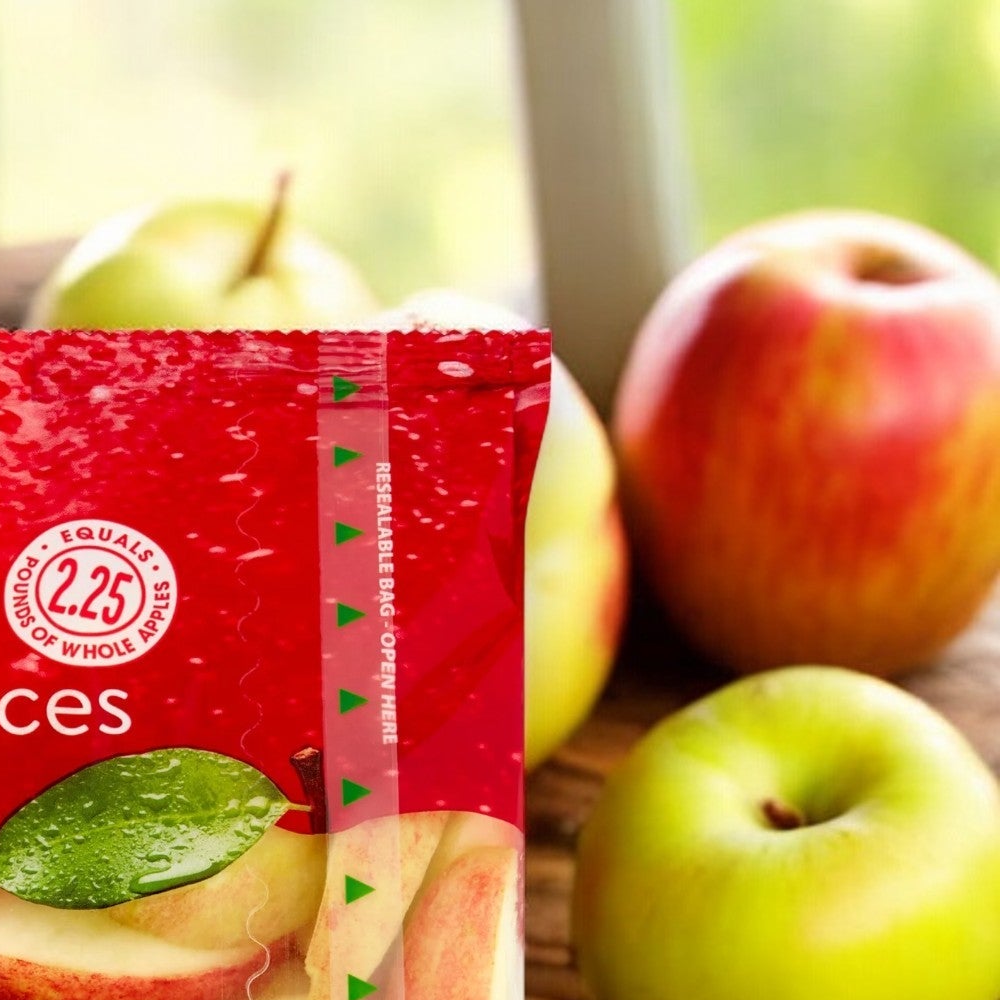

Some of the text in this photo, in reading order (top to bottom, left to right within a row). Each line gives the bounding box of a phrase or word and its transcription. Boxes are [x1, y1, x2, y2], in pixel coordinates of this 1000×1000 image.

[60, 526, 153, 563] EQUALS
[375, 462, 394, 574] RESEALABLE
[13, 556, 170, 659] POUNDS OF WHOLE APPLES
[48, 557, 133, 625] 2.25
[378, 578, 395, 617] BAG
[380, 632, 397, 690] OPEN
[380, 694, 398, 745] HERE
